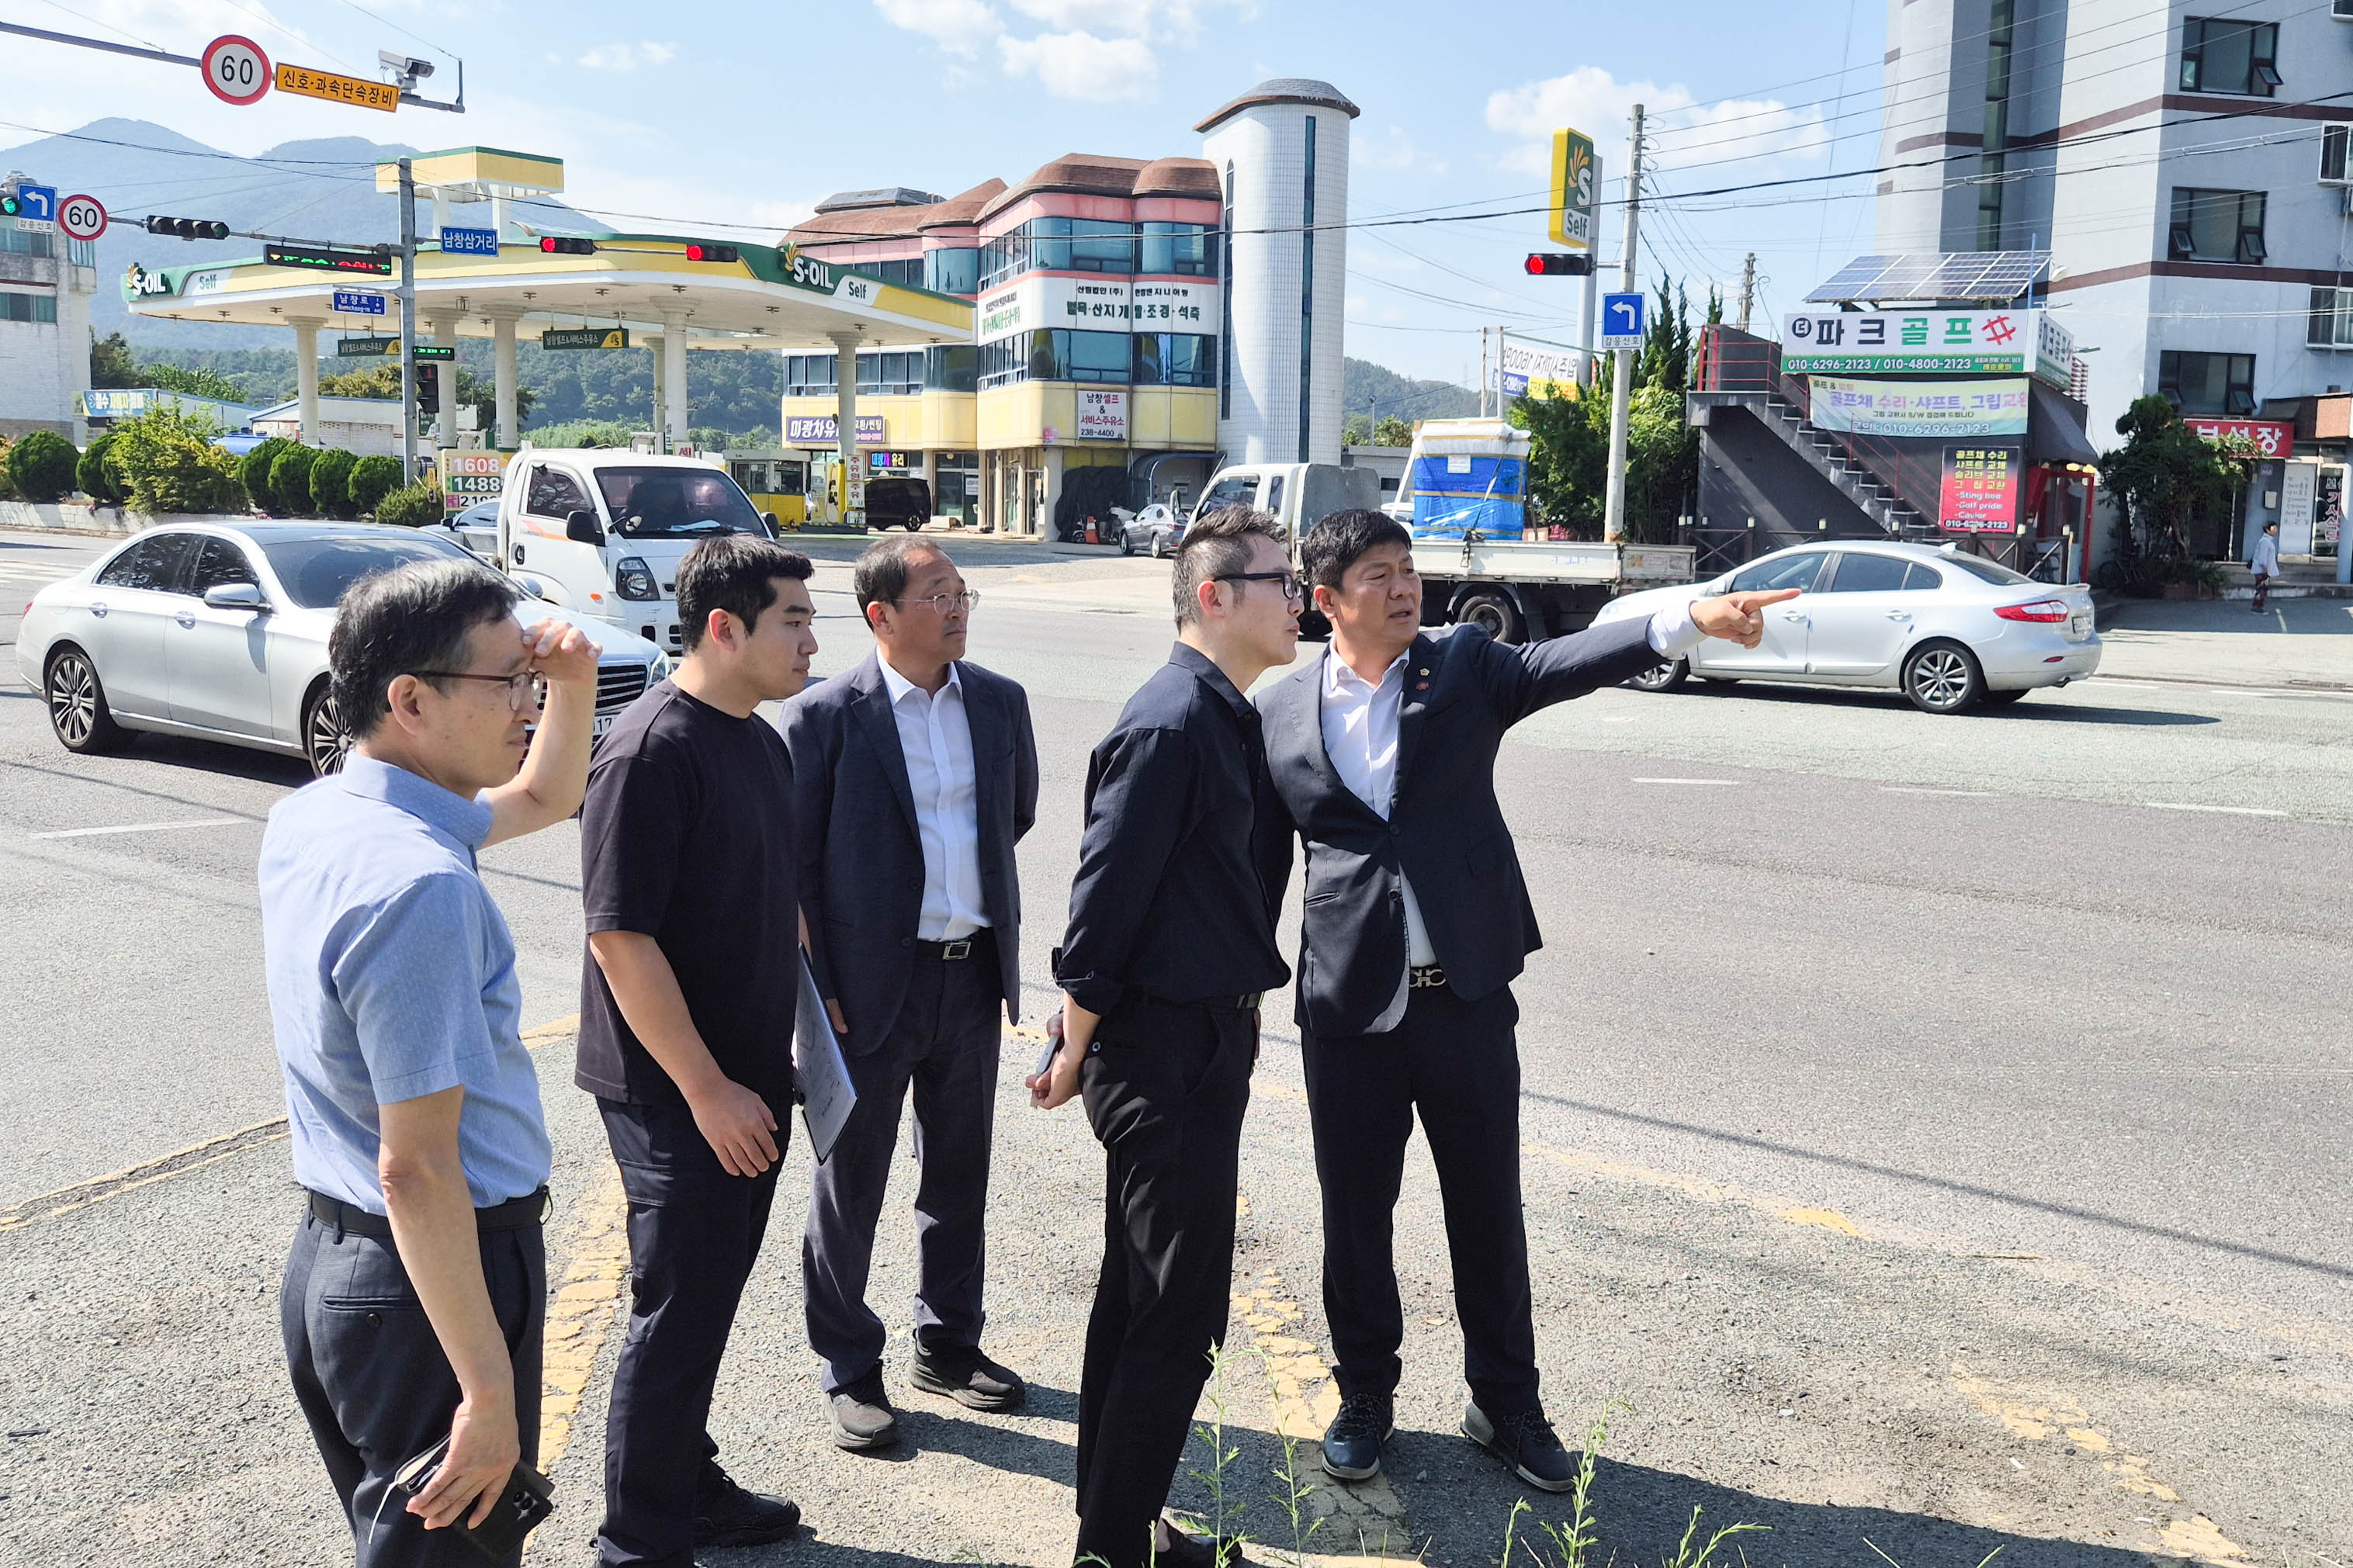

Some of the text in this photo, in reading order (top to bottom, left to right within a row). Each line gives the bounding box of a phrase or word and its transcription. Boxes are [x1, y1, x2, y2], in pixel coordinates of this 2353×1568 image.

[221, 55, 254, 85] 60
[1576, 168, 1591, 206] S
[68, 206, 98, 228] 60
[19, 220, 52, 230] 감응신호
[1567, 213, 1587, 238] Self
[443, 231, 495, 251] 남창삼거리
[793, 257, 834, 289] S-OIL
[133, 272, 166, 296] S-OIL
[199, 274, 217, 290] Self
[848, 281, 867, 299] Self
[1109, 287, 1123, 296] (주)
[340, 294, 369, 305] 남창로
[1816, 317, 1972, 346] 파크골프
[1604, 336, 1639, 346] 감응신호
[1787, 358, 1872, 370] 010-6296-2123
[1883, 358, 1971, 369] 010-4800-2123
[1086, 393, 1119, 404] 남창셀프
[1099, 405, 1106, 414] &
[1080, 415, 1125, 426] 서비스주유소
[789, 419, 840, 438] 미광차유
[1080, 428, 1114, 437] 238-4400
[1883, 424, 1991, 434] 010-6296-2123
[891, 452, 905, 467] 유리
[1987, 450, 2007, 459] 수리
[453, 457, 501, 472] 1608
[453, 476, 501, 491] 1488
